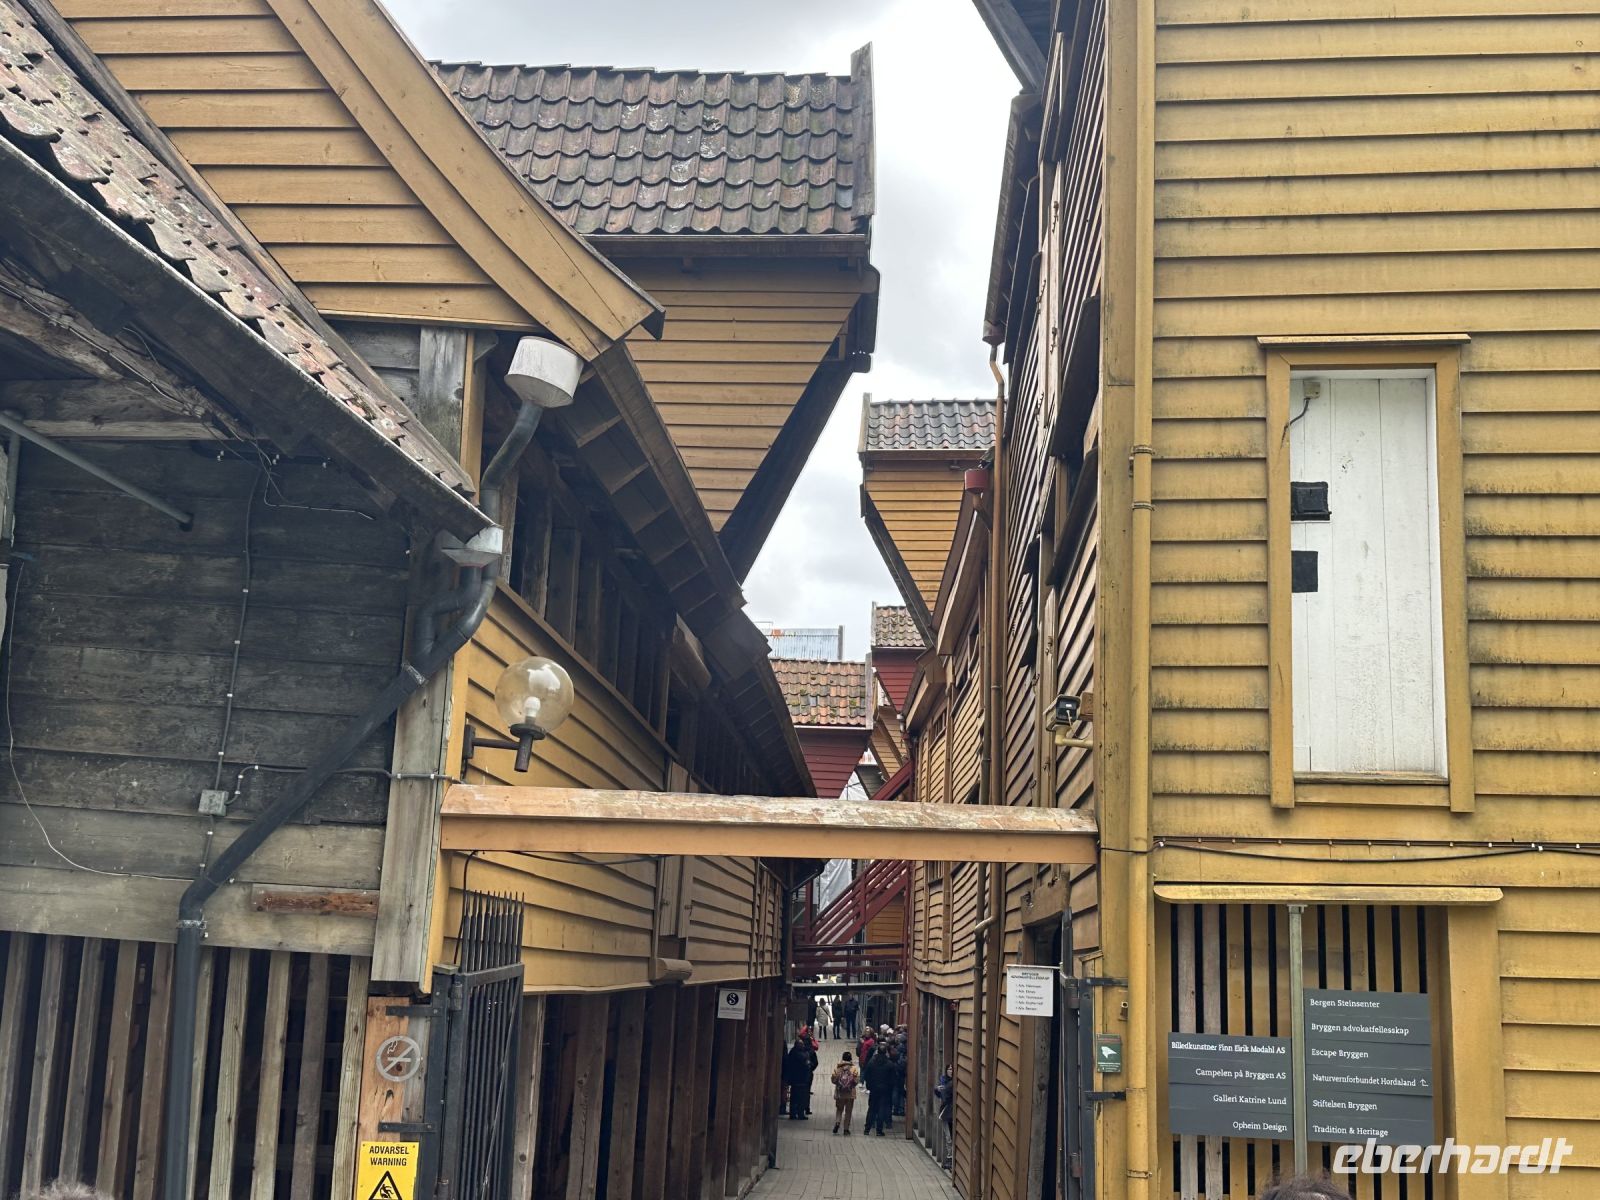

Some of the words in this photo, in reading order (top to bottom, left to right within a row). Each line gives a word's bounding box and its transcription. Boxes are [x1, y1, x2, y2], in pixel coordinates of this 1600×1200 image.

[1310, 999, 1336, 1008] Bergen
[1337, 1000, 1380, 1008] Steinsenter
[1312, 1024, 1341, 1032] Bryggen
[1342, 1025, 1409, 1036] advokatfellesskap
[1171, 1042, 1217, 1051] Billedkunstner
[1235, 1044, 1249, 1052] Eirik
[1250, 1045, 1274, 1053] Modahl
[1312, 1049, 1337, 1058] Escape
[1339, 1050, 1369, 1059] Bryggen
[1195, 1069, 1233, 1077] Campelen
[1234, 1070, 1243, 1079] på
[1245, 1071, 1274, 1080] Bryggen
[1313, 1074, 1379, 1085] Naturvernforbundet
[1381, 1077, 1416, 1087] Hordaland
[1239, 1096, 1266, 1104] Katrine
[1268, 1097, 1286, 1105] Lund
[1312, 1100, 1346, 1109] Stiftelsen
[1348, 1102, 1377, 1111] Bryggen
[1233, 1121, 1261, 1129] Opheim
[1263, 1123, 1287, 1132] Design
[1357, 1128, 1388, 1137] Heritage
[369, 1146, 409, 1154] ADVARSEL
[371, 1158, 407, 1166] WARNING
